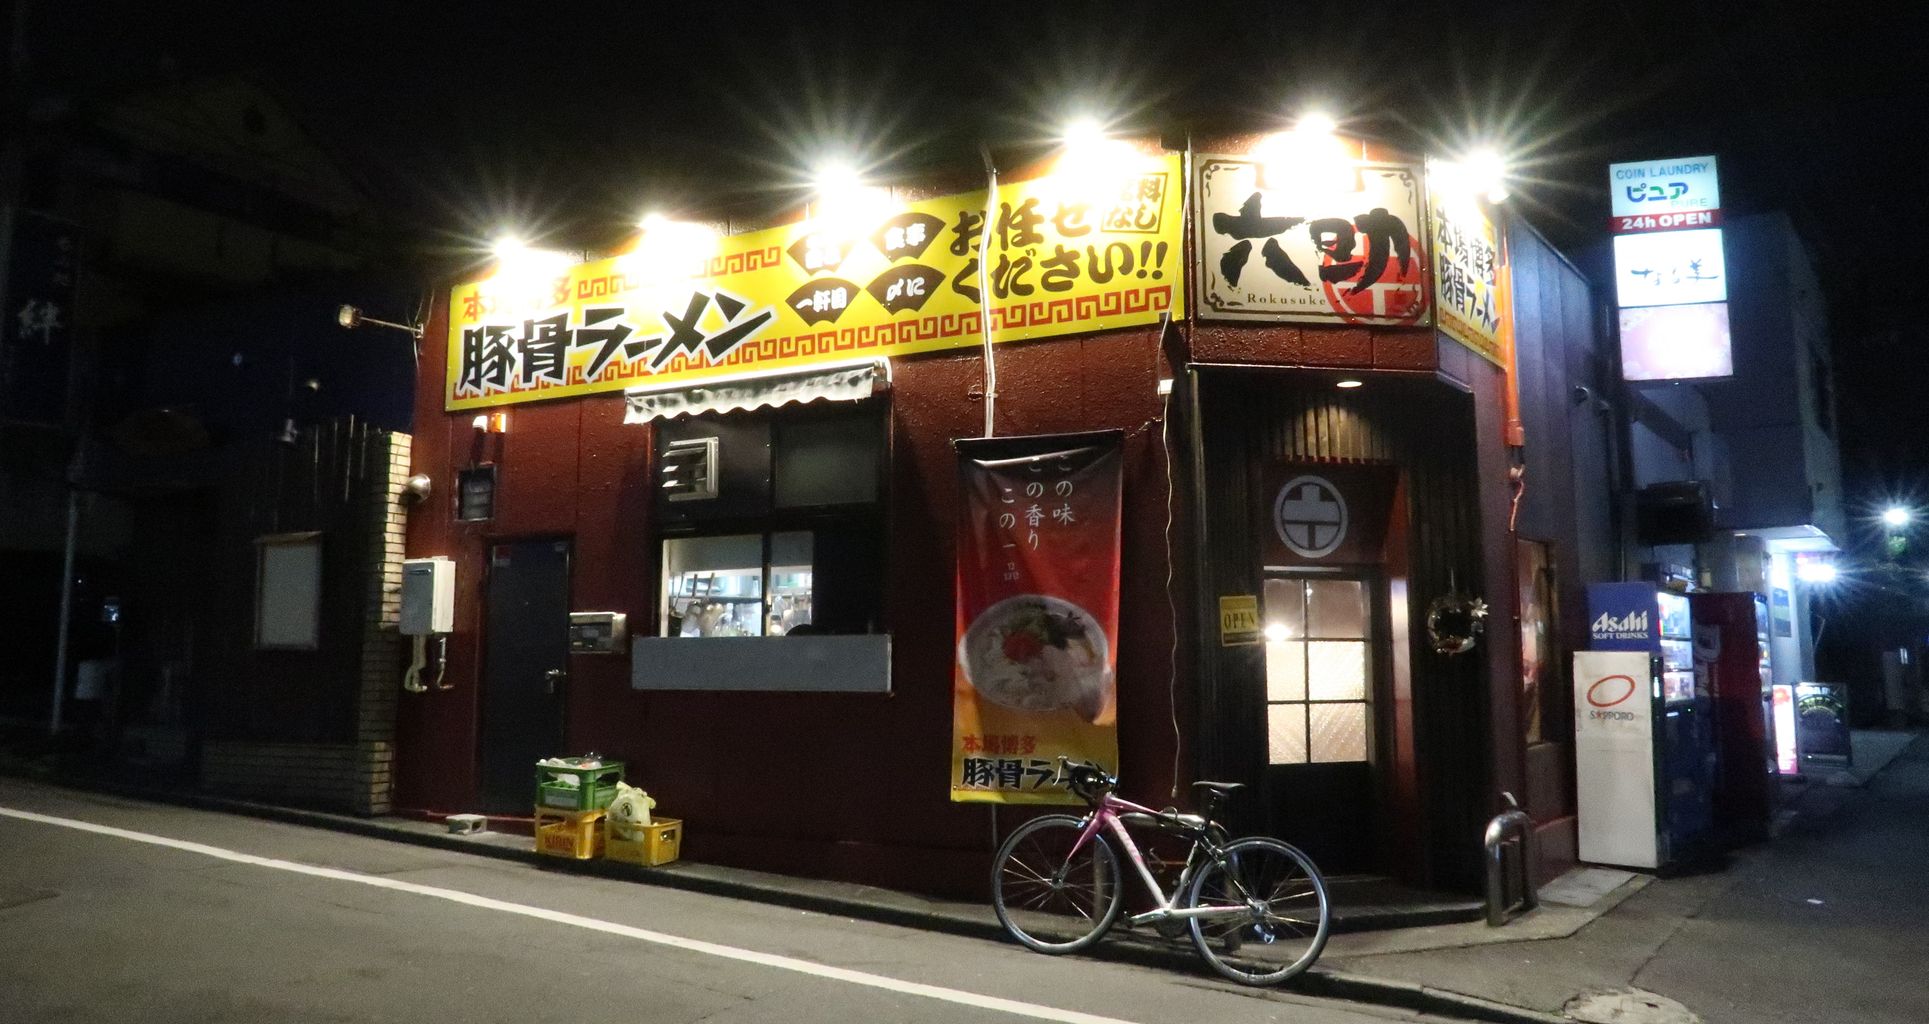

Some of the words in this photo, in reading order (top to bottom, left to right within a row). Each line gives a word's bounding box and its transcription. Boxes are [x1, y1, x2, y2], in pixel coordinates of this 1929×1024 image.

[1616, 167, 1646, 179] COIN
[1650, 163, 1709, 177] LAUNDRY
[1626, 182, 1689, 203] ピュア
[950, 197, 1091, 257] お任せ
[1105, 202, 1157, 230] なし
[1622, 215, 1656, 230] 24h
[1660, 212, 1712, 228] OPEN
[796, 286, 847, 313] 一軒目
[1247, 293, 1326, 306] Rokusuke
[458, 290, 773, 393] 豚骨ラーメン
[1052, 454, 1077, 527] この味
[1023, 456, 1046, 551] この香り
[1224, 612, 1255, 630] OPEN
[1592, 609, 1648, 632] Asahi
[1592, 631, 1614, 640] SOFT
[1615, 631, 1649, 640] DRINKS
